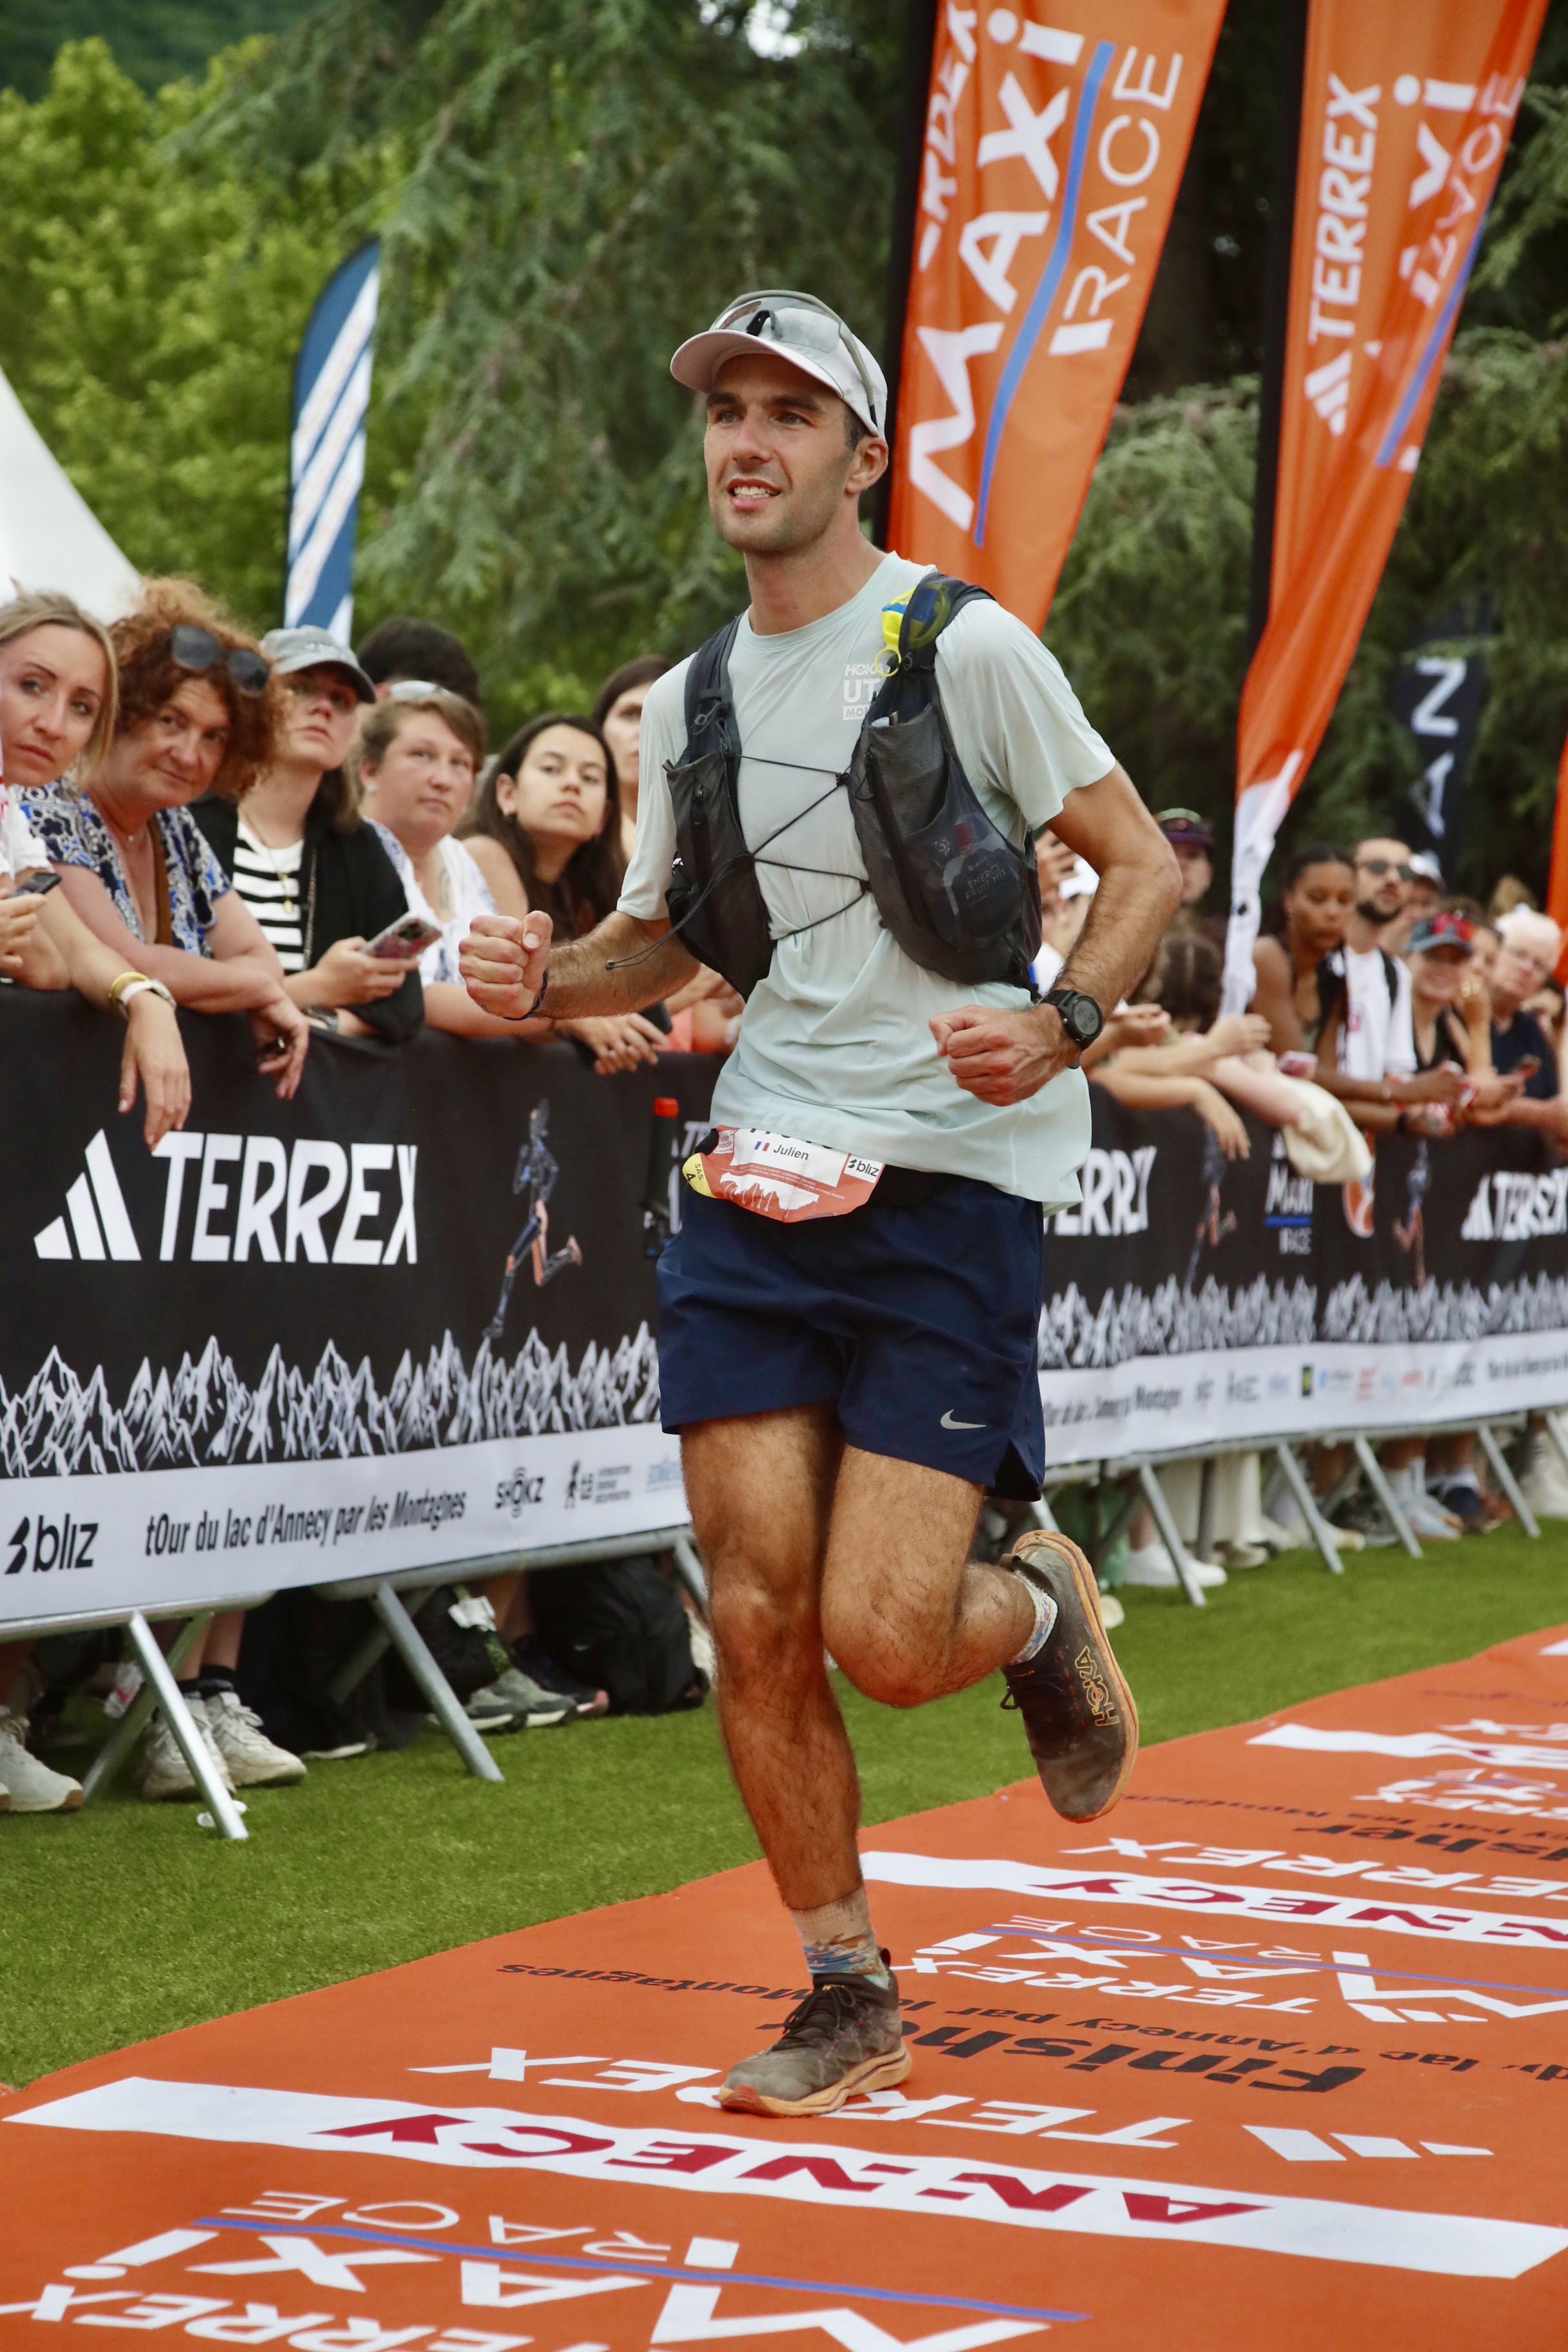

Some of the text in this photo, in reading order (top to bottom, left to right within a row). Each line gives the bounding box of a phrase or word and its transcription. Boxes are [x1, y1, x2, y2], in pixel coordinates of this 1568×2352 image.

[1309, 72, 1382, 346] TERREX
[910, 8, 1084, 531] MAXi
[695, 1163, 704, 1180] SAS
[774, 1144, 809, 1161] Julien
[152, 1131, 417, 1264] TERREX
[195, 1510, 219, 1551] du
[223, 1507, 252, 1549] lac
[257, 1504, 333, 1547] d'Annecy
[333, 1504, 366, 1545] par
[364, 1494, 389, 1533] les
[389, 1488, 467, 1531] Montagnes
[1075, 1645, 1121, 1727] HOKA
[1058, 1836, 1568, 1901] ERREX
[994, 1914, 1322, 1959] RACE
[894, 1956, 1319, 2014] TERREX
[945, 2007, 1063, 2024] par
[1066, 2018, 1360, 2056] d'Annecy
[1378, 2050, 1480, 2072] lac
[309, 2113, 1275, 2224] ANNECY
[220, 2190, 675, 2262] RACE
[0, 2284, 610, 2352] ERREX
